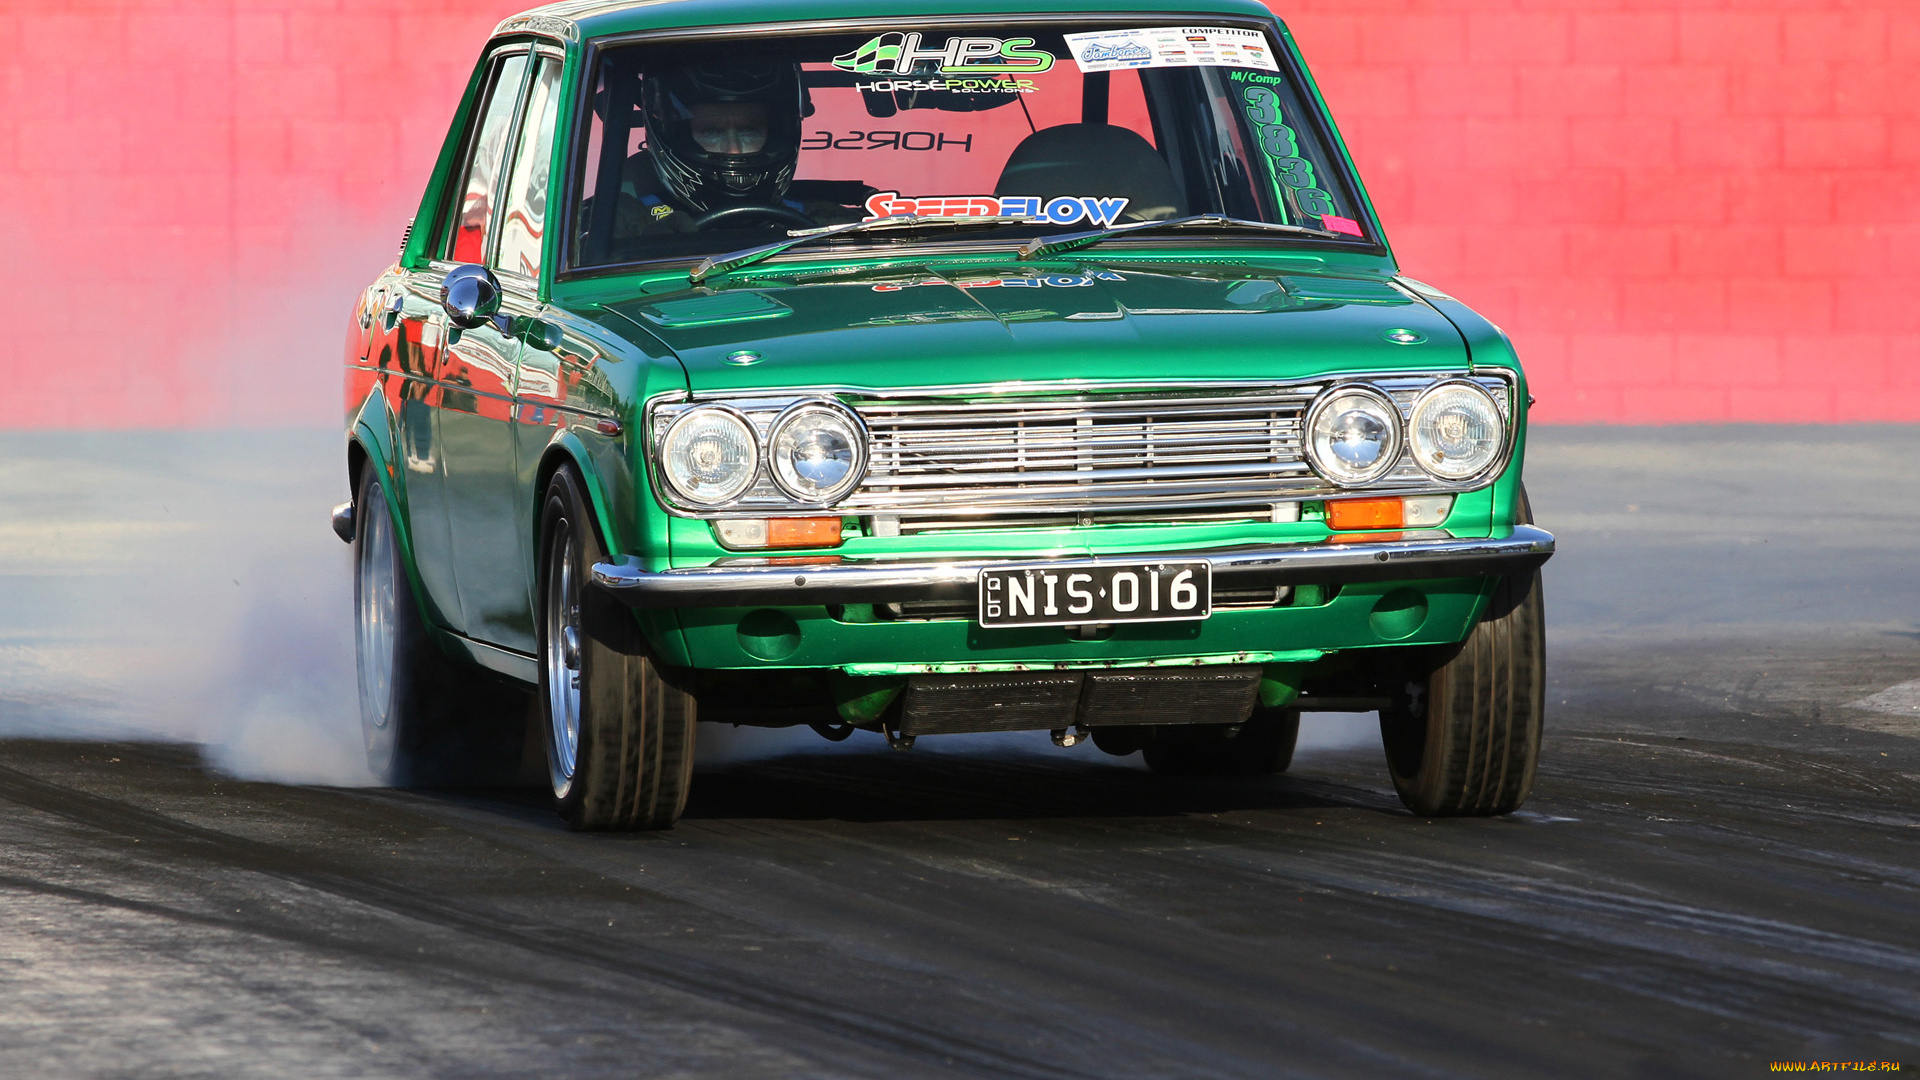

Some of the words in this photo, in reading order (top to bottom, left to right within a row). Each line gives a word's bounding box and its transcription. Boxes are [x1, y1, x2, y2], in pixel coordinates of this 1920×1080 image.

[1182, 28, 1259, 37] COMPETITOR
[897, 32, 1056, 75] HPS
[1082, 44, 1149, 62] Jamboree
[856, 79, 1040, 93] HORSEPOWER
[1230, 71, 1281, 86] M/Comp
[1243, 86, 1336, 220] 3836
[863, 193, 1129, 228] SPEEDFLOW
[987, 577, 1001, 617] QLD
